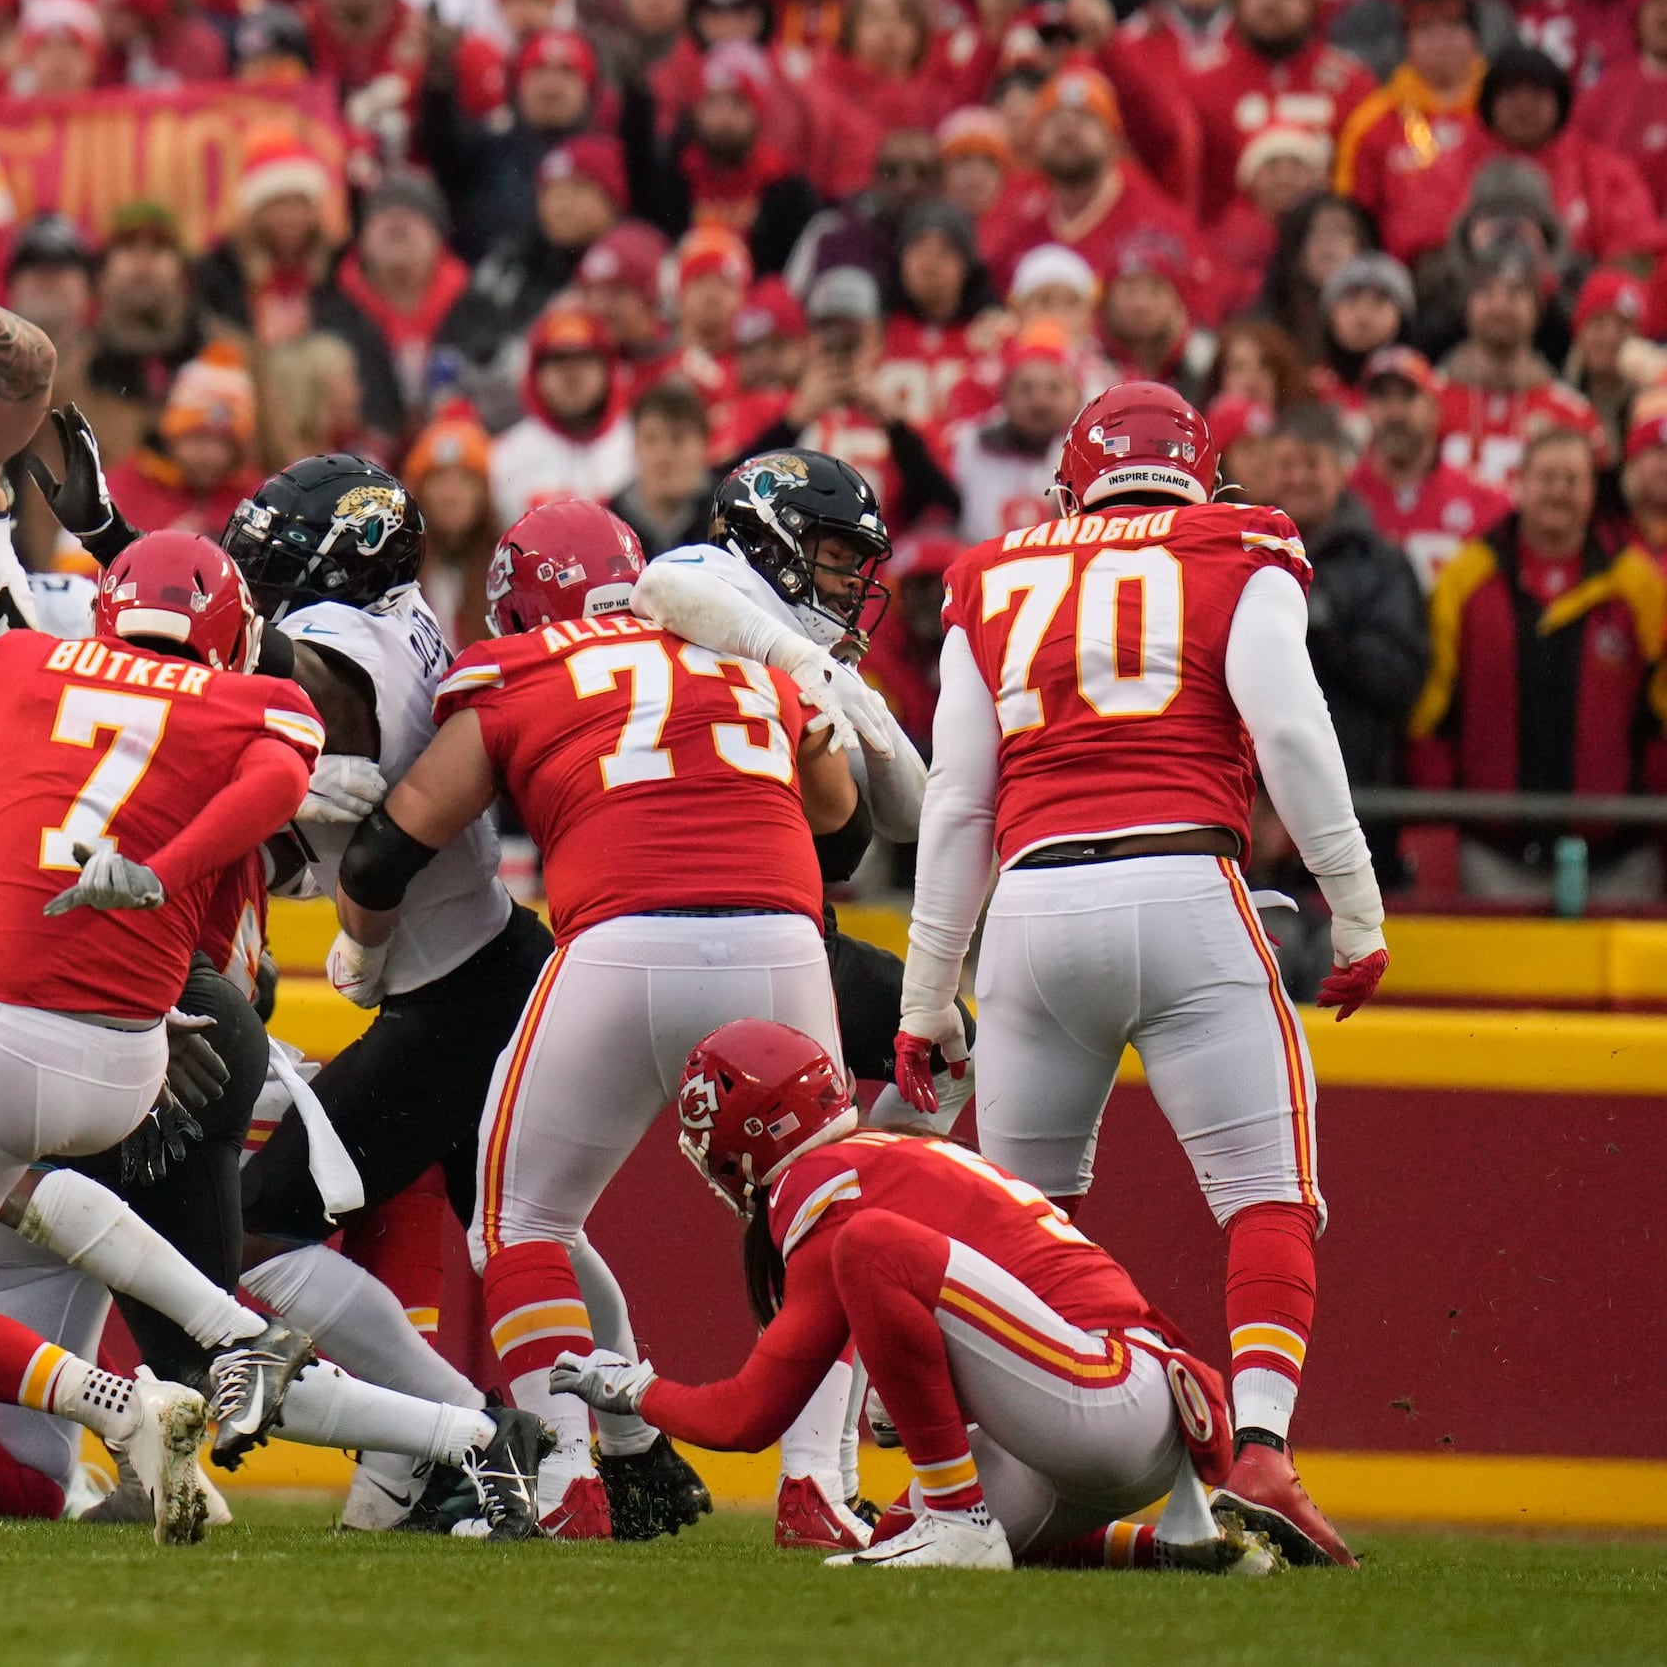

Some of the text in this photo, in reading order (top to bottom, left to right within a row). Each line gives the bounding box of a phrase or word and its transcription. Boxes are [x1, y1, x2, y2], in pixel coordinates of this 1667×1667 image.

[1108, 471, 1191, 490] INSPIRE CHANGE
[592, 600, 615, 611] STOP
[981, 545, 1183, 738] 70
[45, 638, 212, 696] BUTKER
[567, 637, 793, 792] 73
[39, 683, 171, 873] 7
